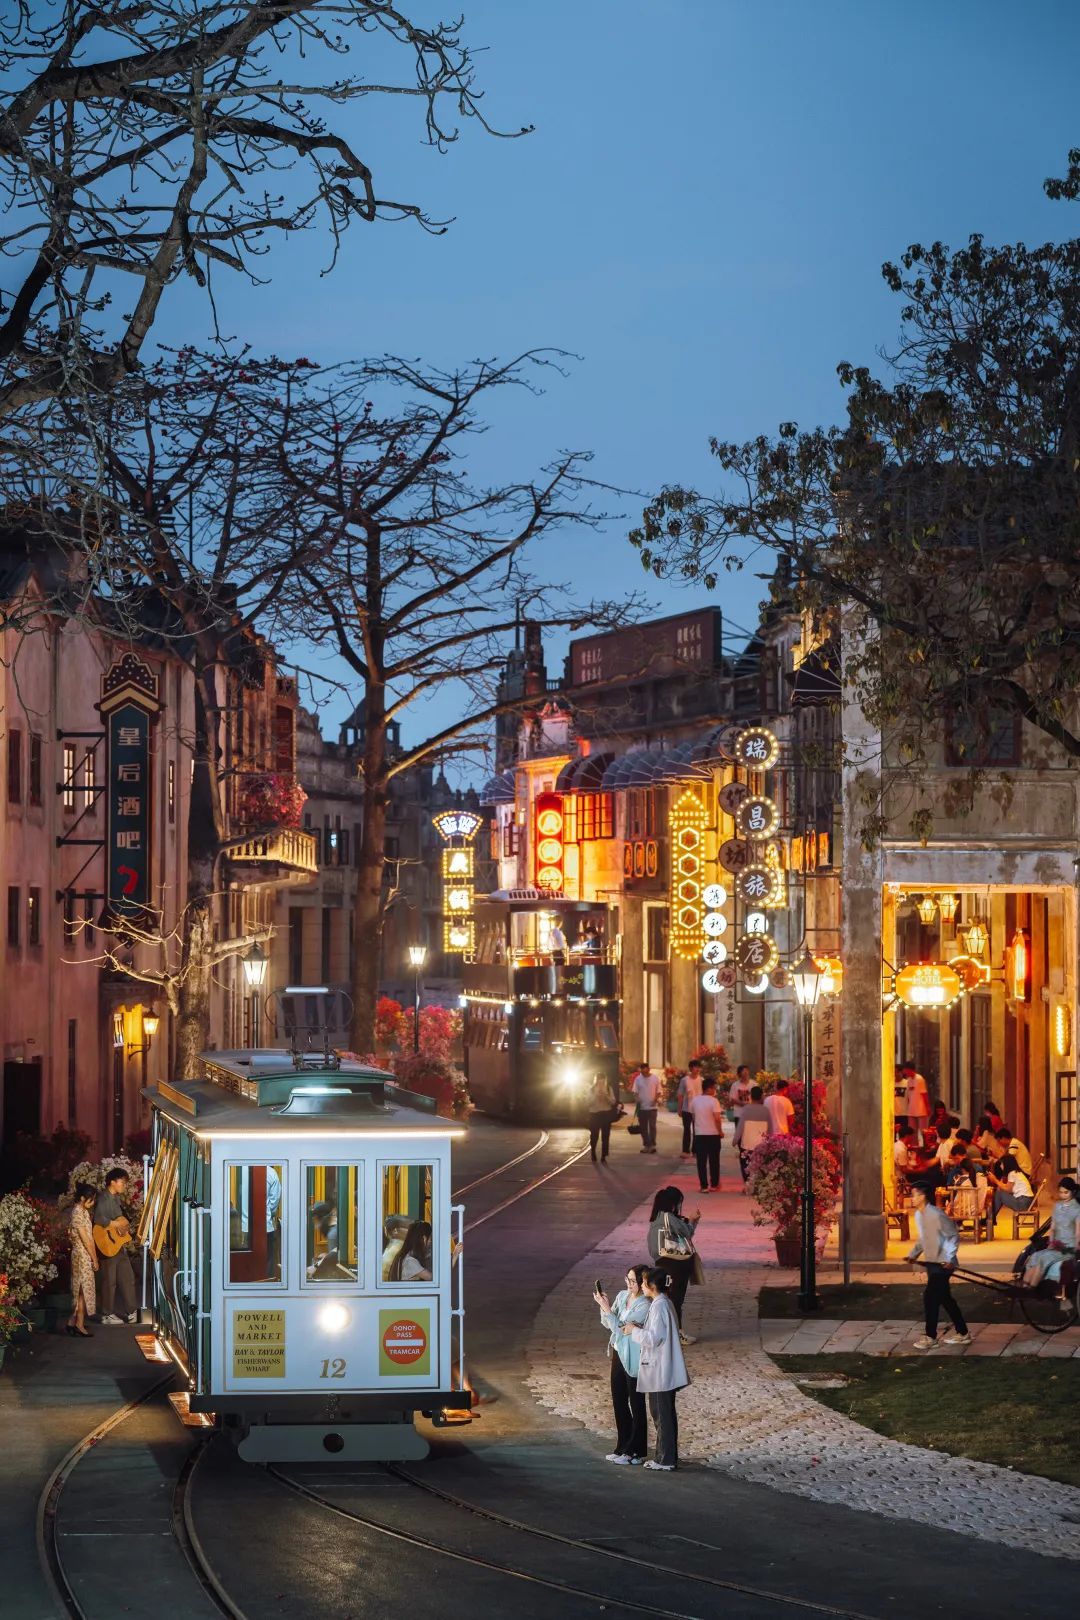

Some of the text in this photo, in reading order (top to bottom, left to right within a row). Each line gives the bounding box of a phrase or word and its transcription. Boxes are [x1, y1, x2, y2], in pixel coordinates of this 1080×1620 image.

[116, 727, 141, 850] 皇后酒吧
[744, 737, 768, 964] 瑞昌旅店
[912, 975, 942, 985] HOTEL
[236, 1314, 283, 1322] POWELL
[237, 1332, 282, 1340] MARKET
[319, 1358, 347, 1379] 12
